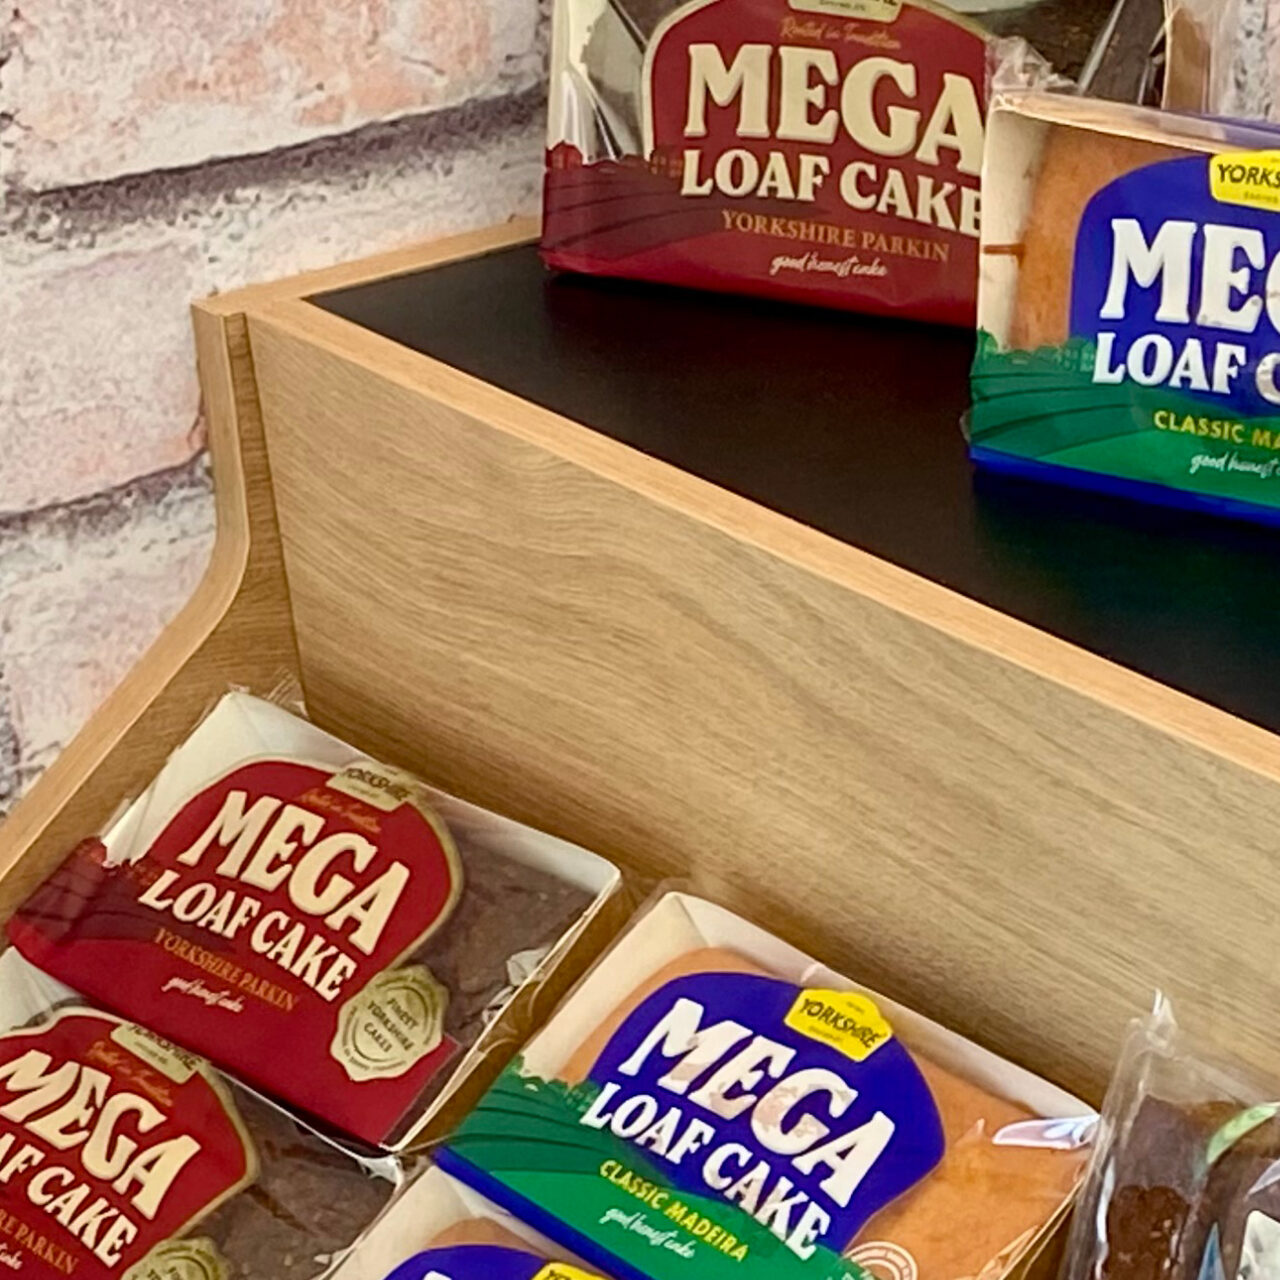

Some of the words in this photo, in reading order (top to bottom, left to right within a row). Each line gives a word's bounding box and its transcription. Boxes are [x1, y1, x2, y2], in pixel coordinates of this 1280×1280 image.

[684, 43, 985, 178] MEGA
[681, 149, 831, 202] LOAF
[839, 161, 982, 238] CAKE
[721, 209, 857, 249] YORKSHIRE
[861, 231, 950, 263] PARKIN
[1092, 331, 1248, 395] LOAF
[1154, 410, 1245, 443] CLASSIC
[176, 789, 410, 956] MEGA
[138, 869, 262, 939] LOAF
[251, 910, 358, 1002] CAKE
[155, 927, 243, 984] YORKSHIRE
[237, 972, 299, 1012] PARKIN
[799, 998, 880, 1049] YORKSHIRE
[0, 1049, 201, 1221] MEGA
[618, 997, 896, 1208] MEGA
[27, 1165, 139, 1269] CAKE
[579, 1082, 716, 1165] LOAF
[702, 1142, 831, 1261] CAKE
[600, 1159, 670, 1210] CLASSIC
[663, 1200, 749, 1263] MADEIRA
[14, 1222, 79, 1275] PARKIN
